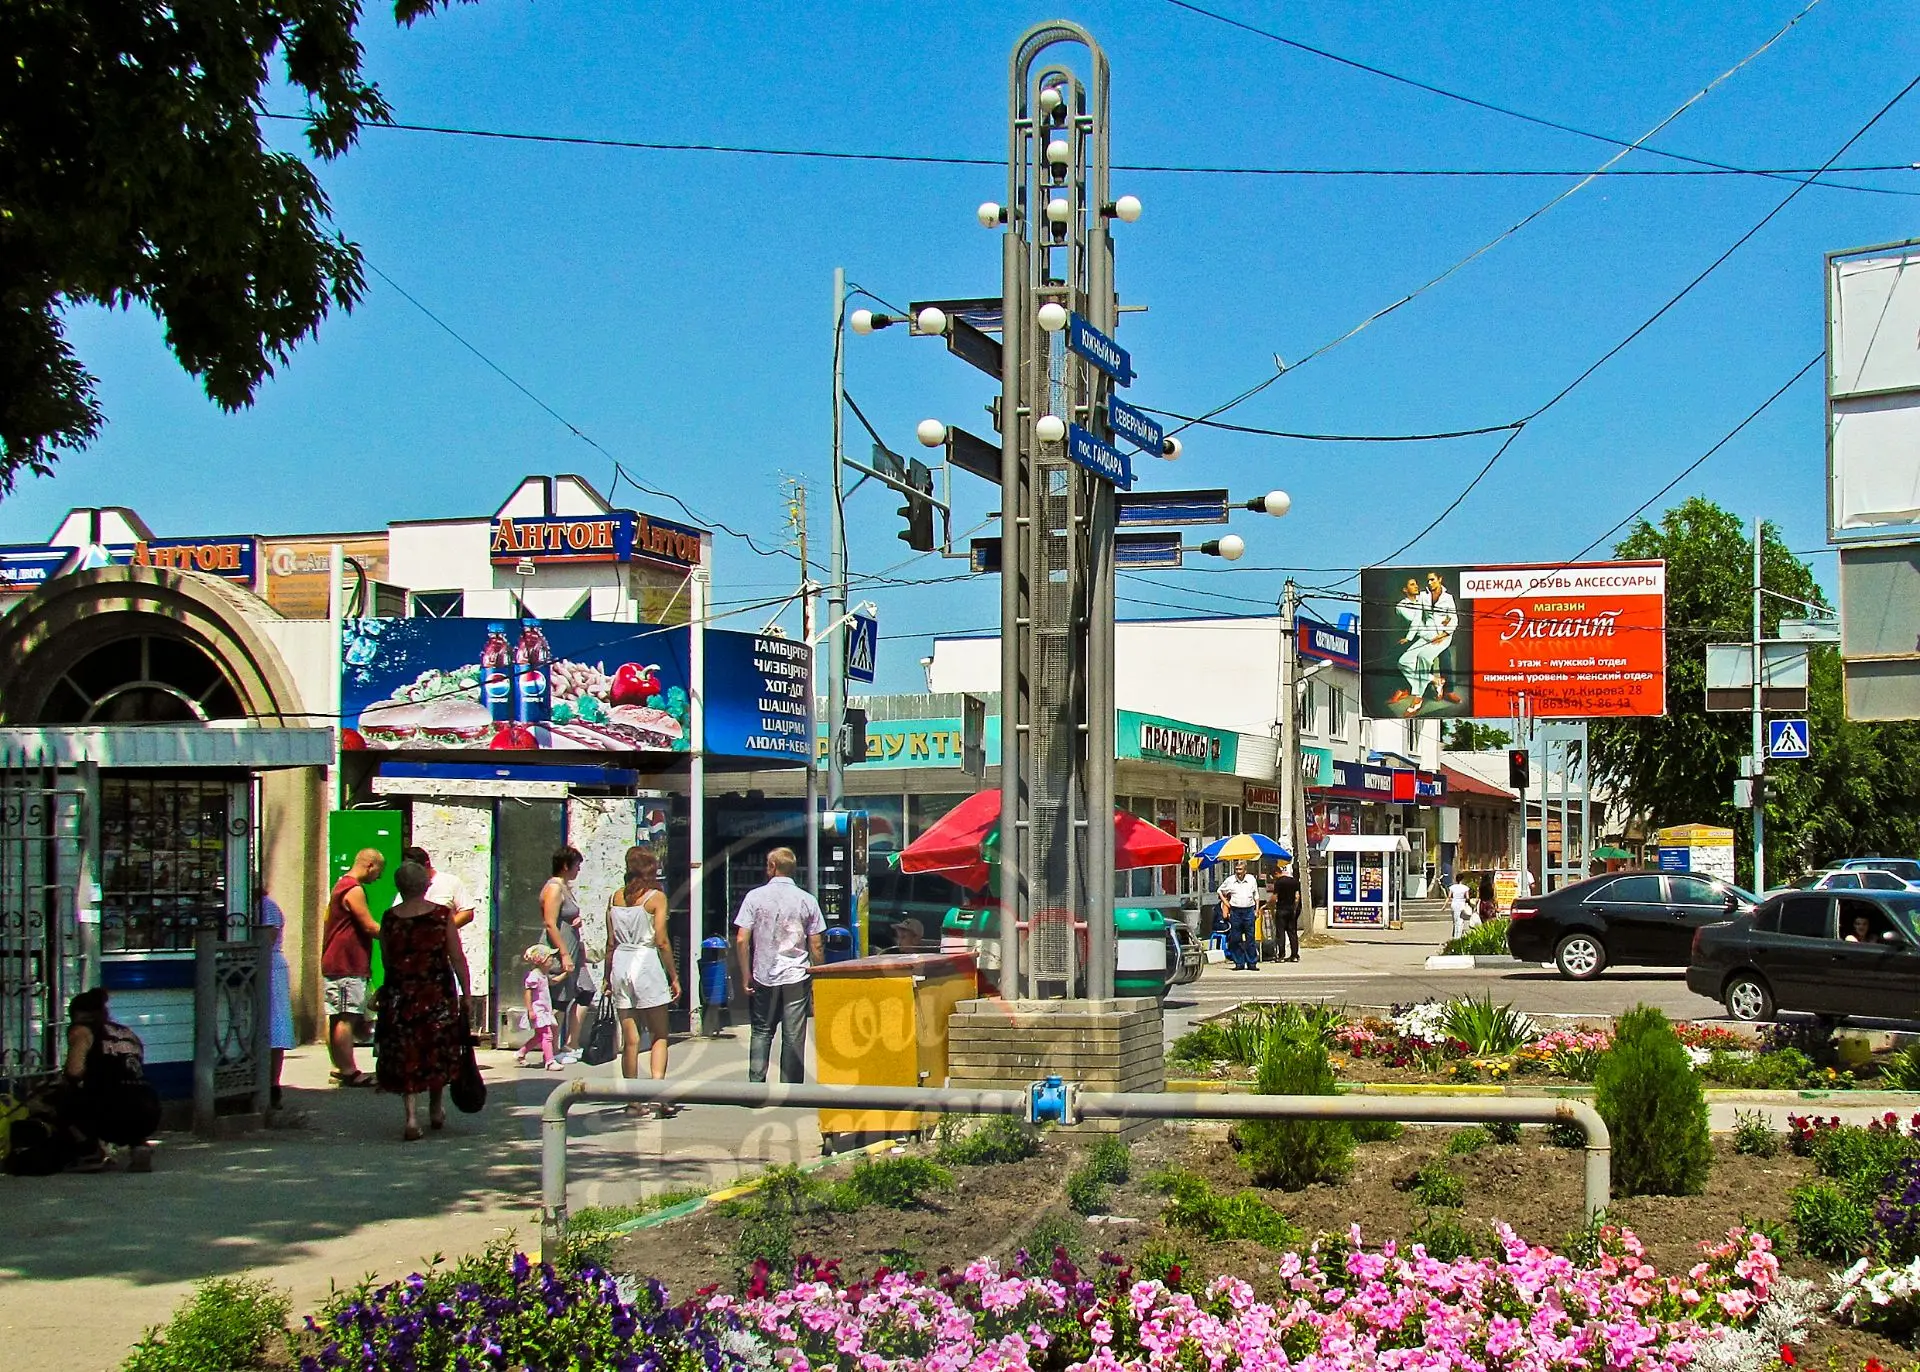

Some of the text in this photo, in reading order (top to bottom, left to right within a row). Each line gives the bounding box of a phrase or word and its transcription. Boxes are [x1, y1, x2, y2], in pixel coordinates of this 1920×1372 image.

[1082, 328, 1121, 370] ЮЖНЫЙ М-Р
[1114, 406, 1159, 446] СЕВЕРНЫЙ М-Р
[1093, 444, 1123, 477] ГАЙДАРА
[1466, 575, 1657, 592] ОДЕЖДА ОБУВЬ АКСЕССУАРЫ
[1533, 601, 1586, 613] магазин
[1500, 607, 1624, 642] Элегант
[754, 639, 808, 660] ГАМБУРГЕР
[754, 658, 808, 679] ЧИЗБУРГЕР
[1508, 658, 1515, 668] 1
[1517, 659, 1541, 669] этаж
[1550, 656, 1596, 671] мужской
[1597, 657, 1627, 669] отдел
[1483, 671, 1525, 683] нижний
[1526, 673, 1569, 684] уровень
[1576, 670, 1622, 682] женский
[1624, 670, 1653, 681] отдел
[765, 679, 804, 698] ХОТ-ДОГ
[1628, 685, 1642, 695] 28
[758, 698, 807, 716] ШАШЛЫК
[762, 718, 805, 736] ШАУРМА
[1145, 726, 1209, 758] ПРОДУКТЫ
